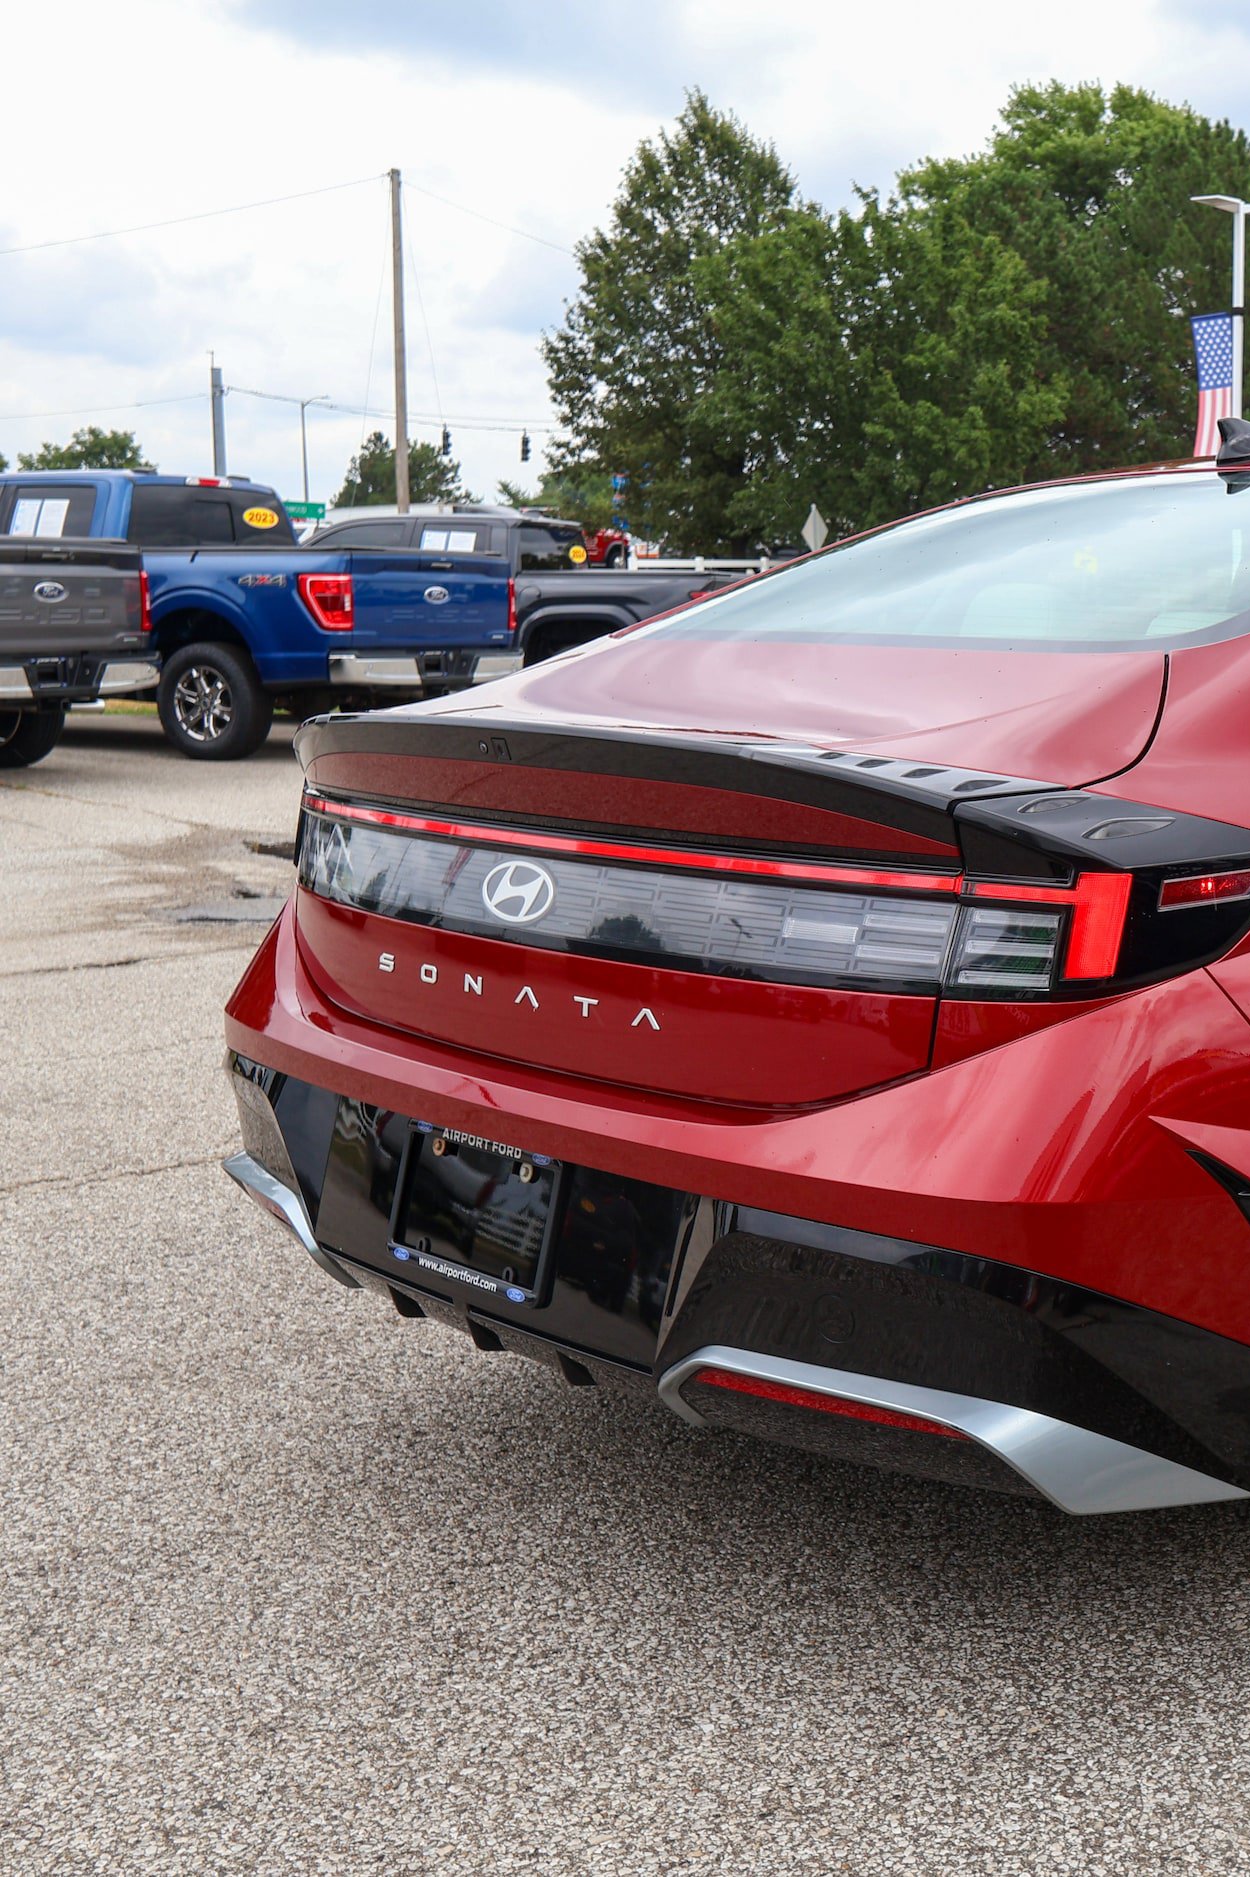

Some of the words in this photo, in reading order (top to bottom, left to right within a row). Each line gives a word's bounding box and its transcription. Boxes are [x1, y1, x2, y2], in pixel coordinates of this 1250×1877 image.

[247, 511, 275, 523] 2023
[379, 953, 661, 1031] SONATA
[442, 1127, 490, 1151] AIRPORT
[491, 1141, 522, 1160] FORD
[418, 1256, 497, 1293] www.airportford.com
